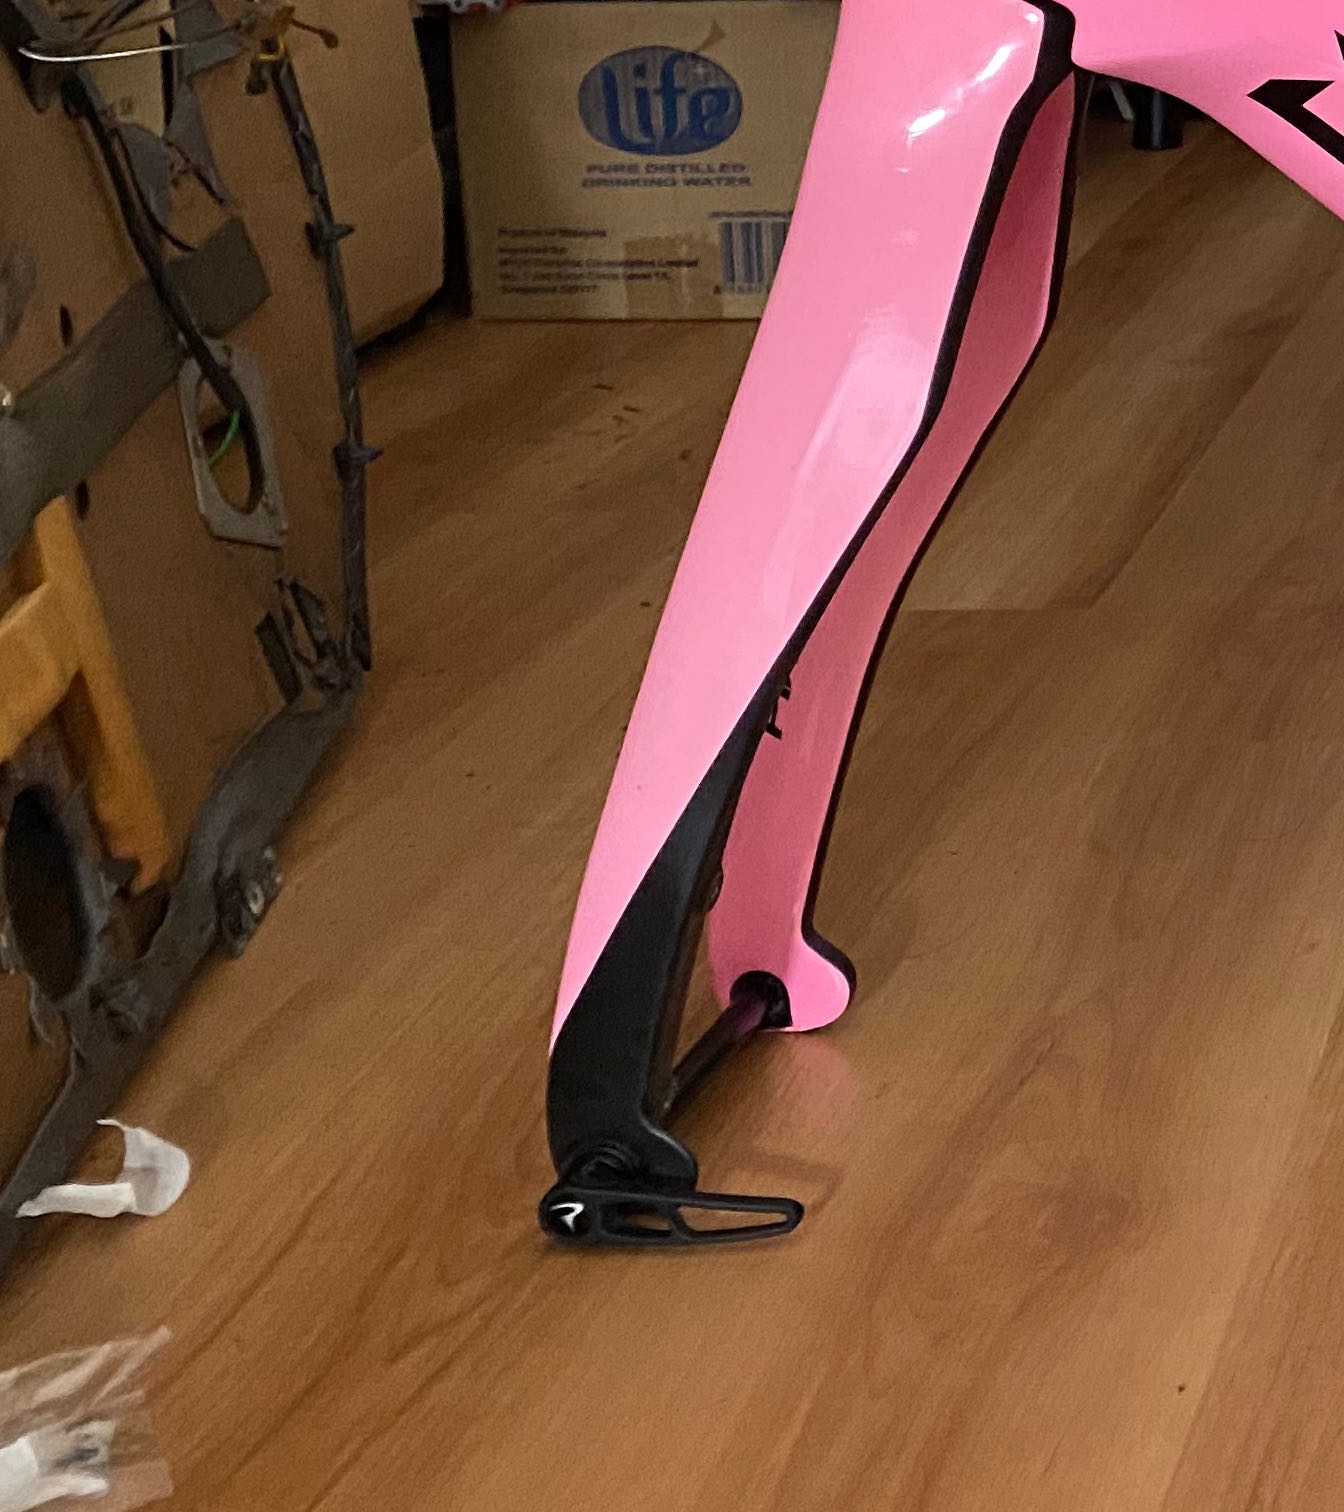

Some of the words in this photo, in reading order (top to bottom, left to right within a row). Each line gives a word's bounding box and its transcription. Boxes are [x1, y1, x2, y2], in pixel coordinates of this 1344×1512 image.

[586, 163, 640, 174] PURE
[645, 163, 746, 174] DISTILLED
[581, 176, 677, 187] DRINKING
[684, 175, 751, 187] WATER
